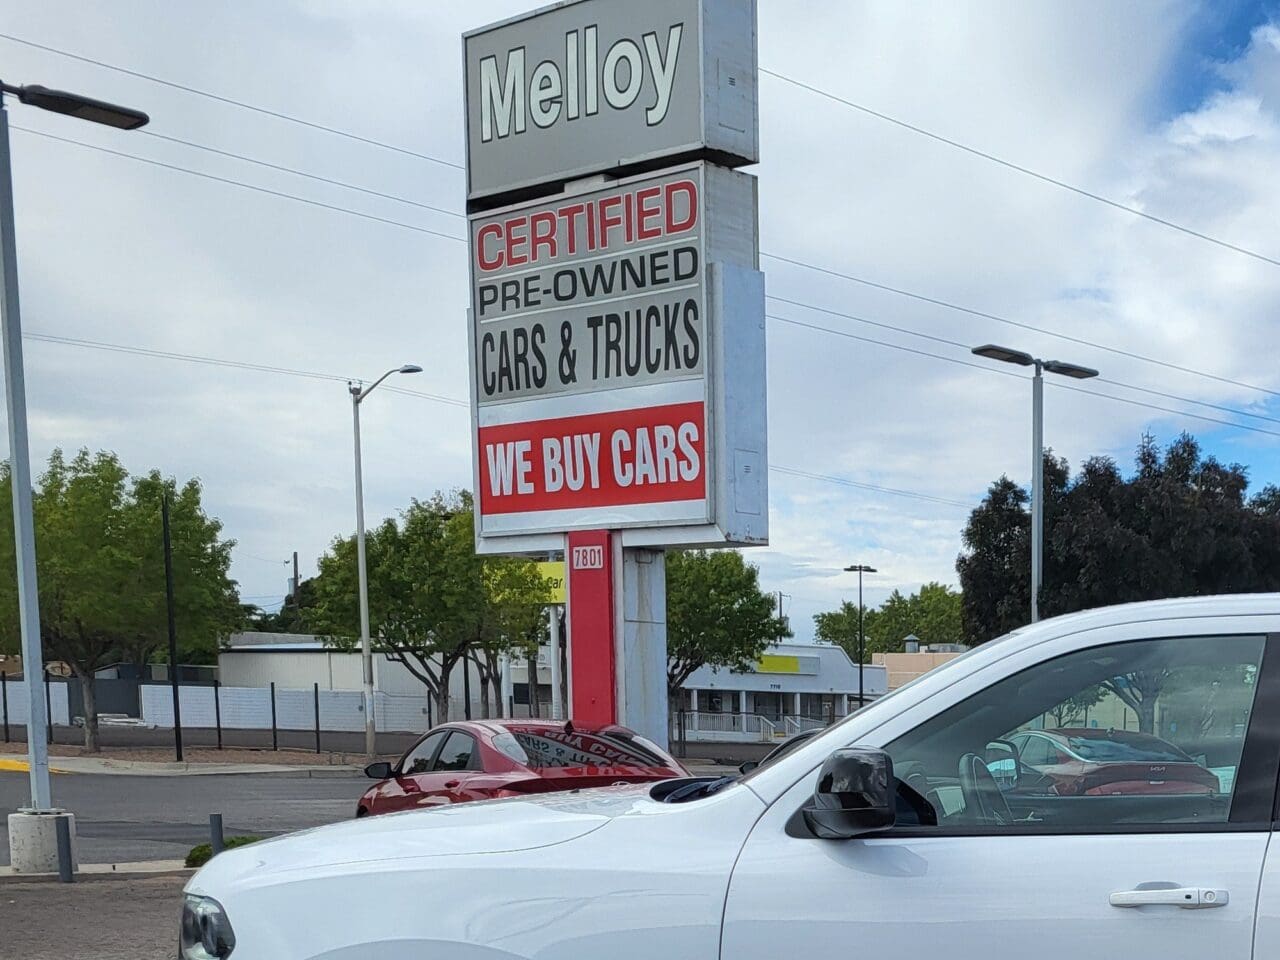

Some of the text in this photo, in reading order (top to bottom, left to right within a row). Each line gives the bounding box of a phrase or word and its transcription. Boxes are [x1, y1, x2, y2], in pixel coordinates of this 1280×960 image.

[478, 22, 684, 144] Melloy
[476, 179, 698, 272] CERTIFIED
[478, 246, 699, 316] PRE-OWNED
[481, 298, 700, 396] CARS & TRUCKS
[486, 422, 700, 497] WE BUY CARS
[575, 548, 602, 568] 7801
